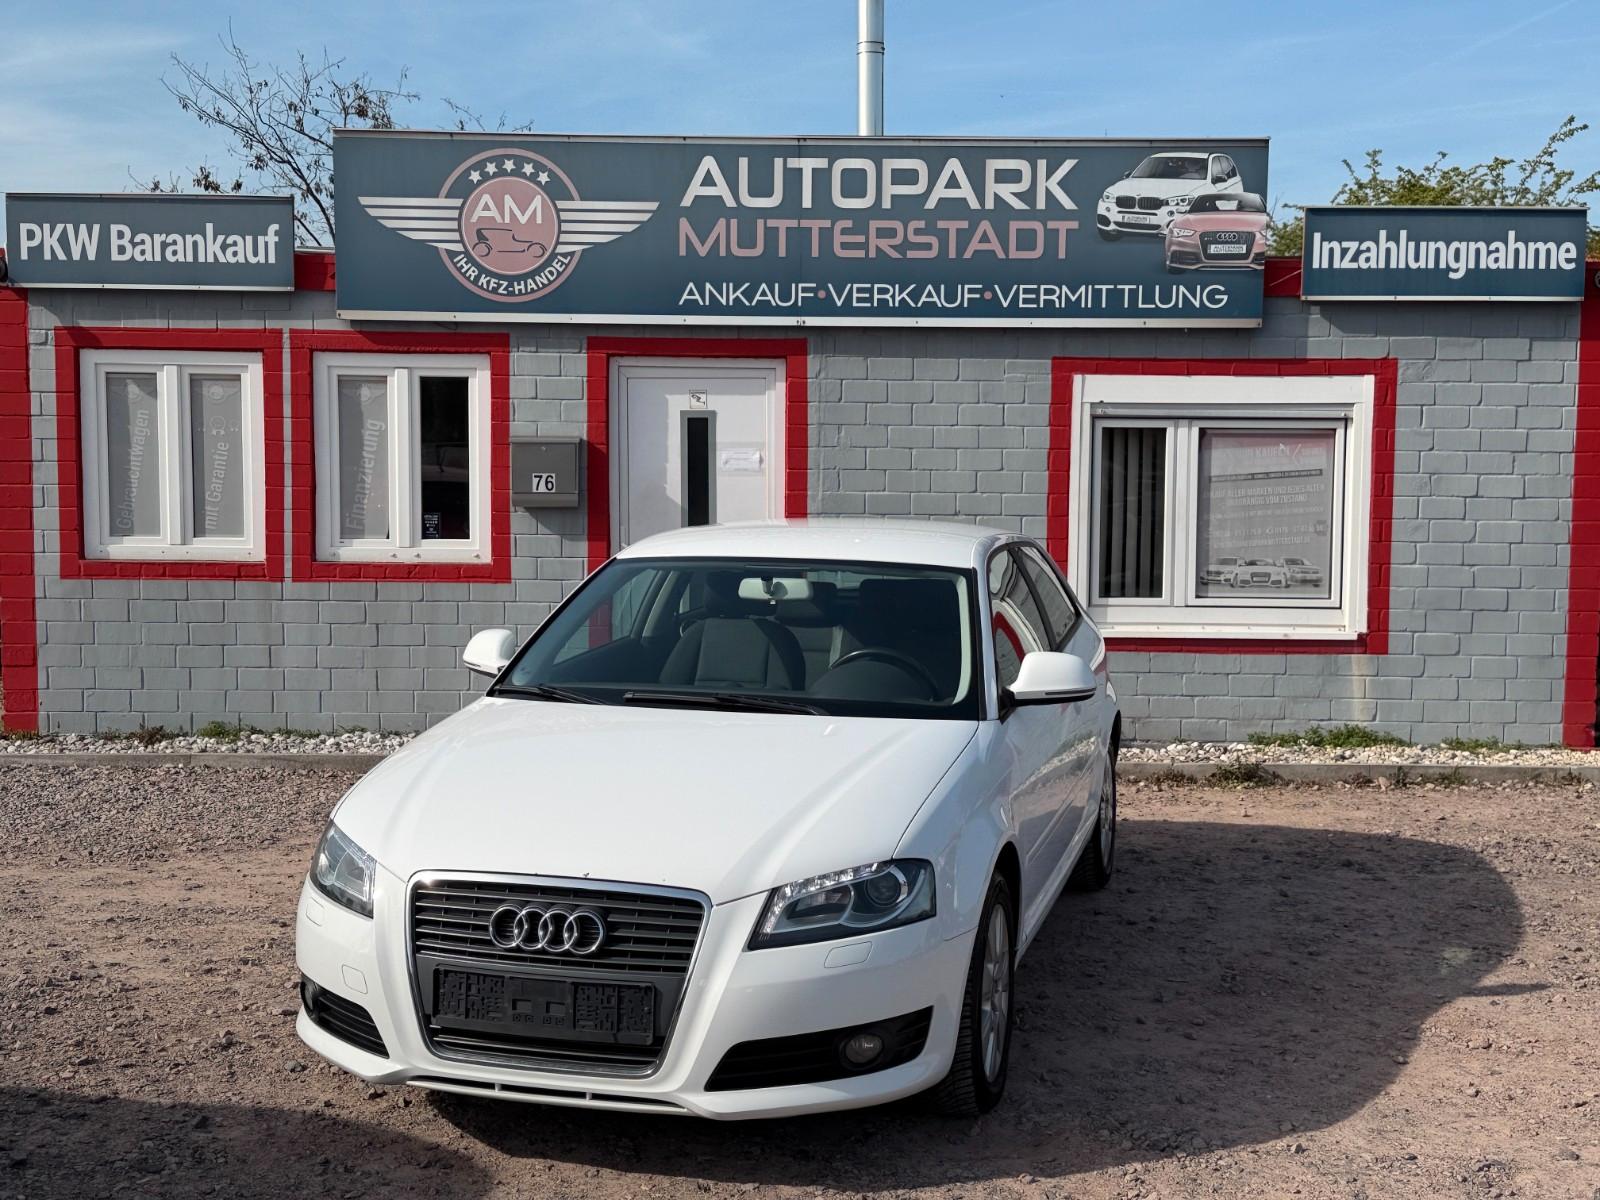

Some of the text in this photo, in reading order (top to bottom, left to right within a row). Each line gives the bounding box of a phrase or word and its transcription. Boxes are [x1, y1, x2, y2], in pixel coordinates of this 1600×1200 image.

[680, 155, 1080, 210] AUTOPARK
[470, 193, 542, 224] AM
[19, 223, 279, 264] PKW Barankauf
[679, 217, 1079, 259] MUTTERSTADT
[1312, 229, 1577, 279] Inzahlungnahme
[453, 254, 571, 295] IHR KFZ-HANDEL
[678, 282, 1229, 309] ANKAUF VERKAUF VERMITTLUNG
[203, 441, 230, 530] mit Garantie
[345, 419, 386, 531] Finanzierung
[533, 474, 554, 492] 76
